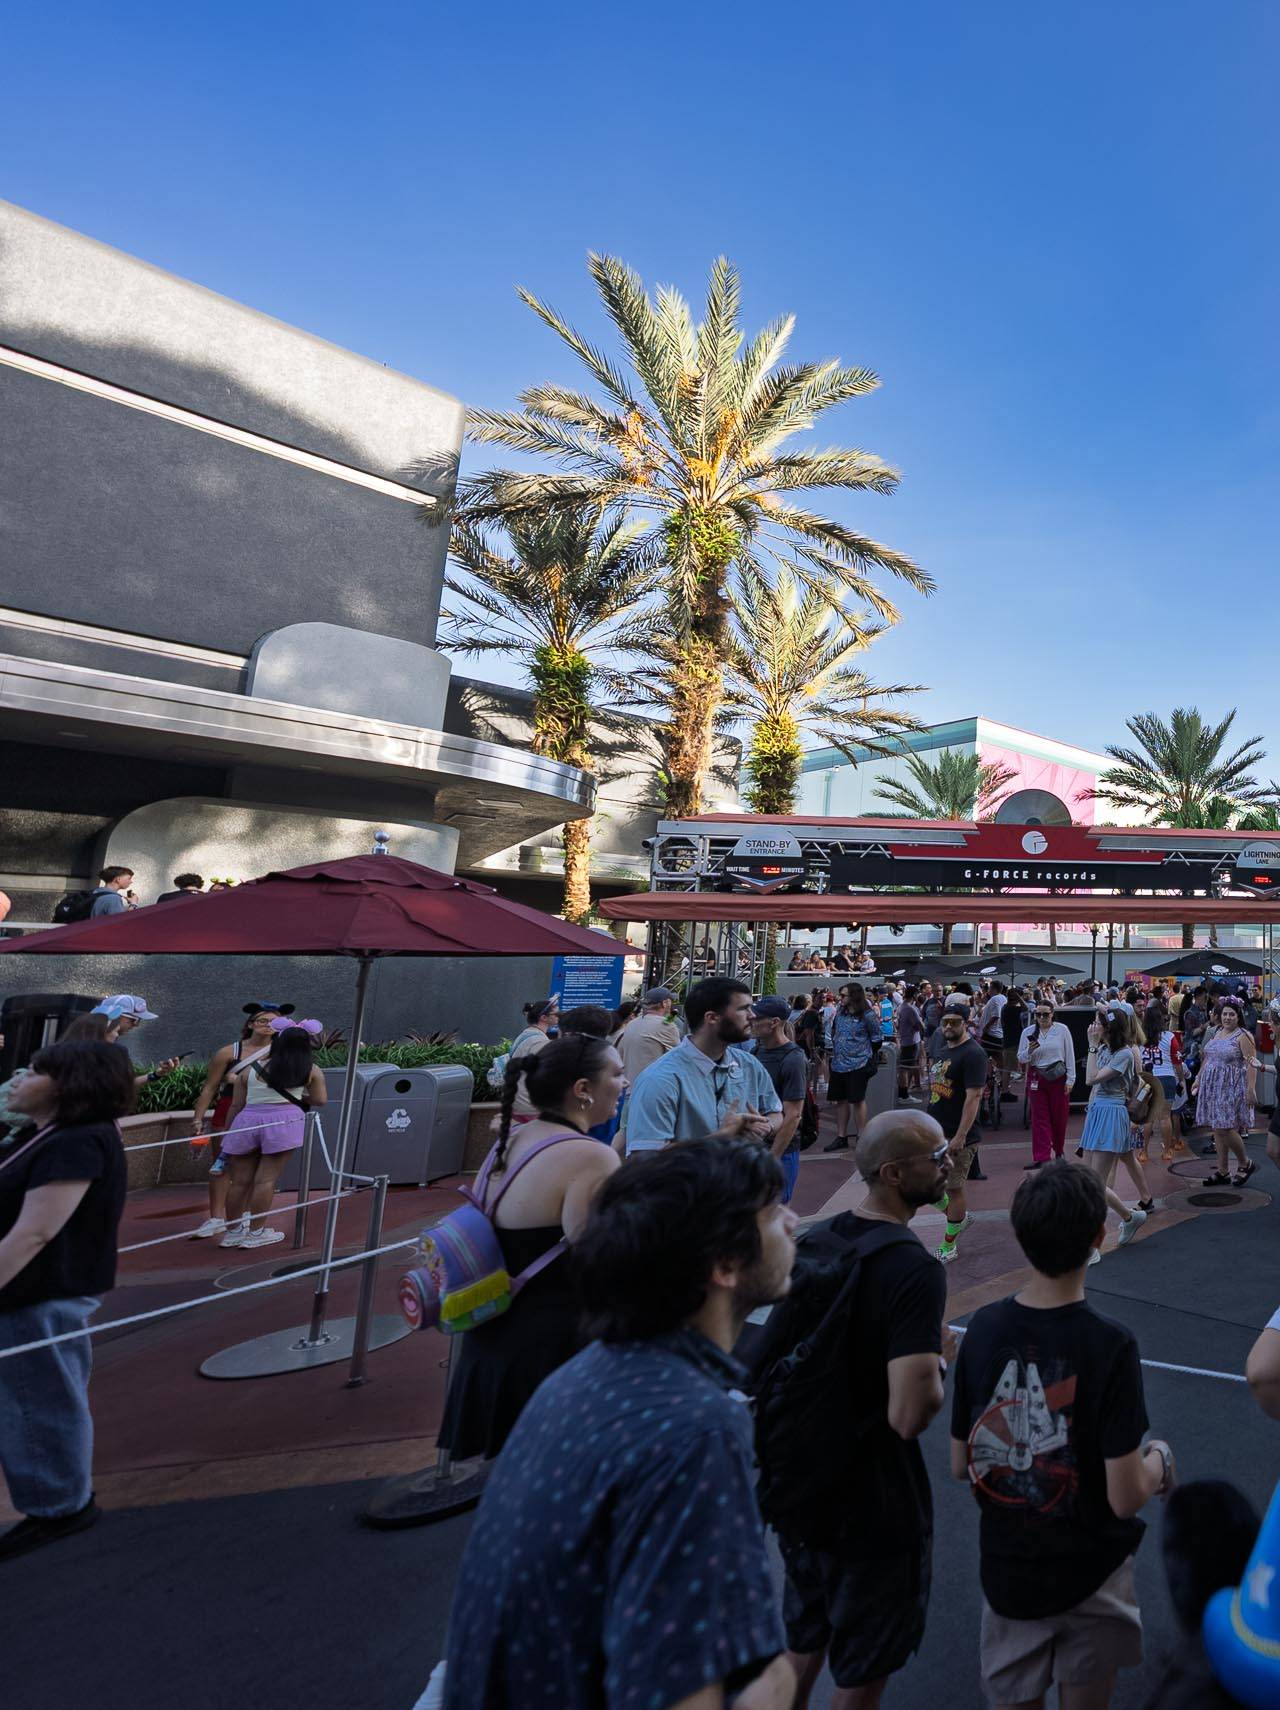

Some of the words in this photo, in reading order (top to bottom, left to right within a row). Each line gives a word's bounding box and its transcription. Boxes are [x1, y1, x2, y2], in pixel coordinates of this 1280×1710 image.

[745, 840, 791, 849] STAND-BY
[1243, 851, 1280, 859] LIGHTNING
[964, 869, 1029, 879] G-FORCE
[1037, 871, 1097, 880] records
